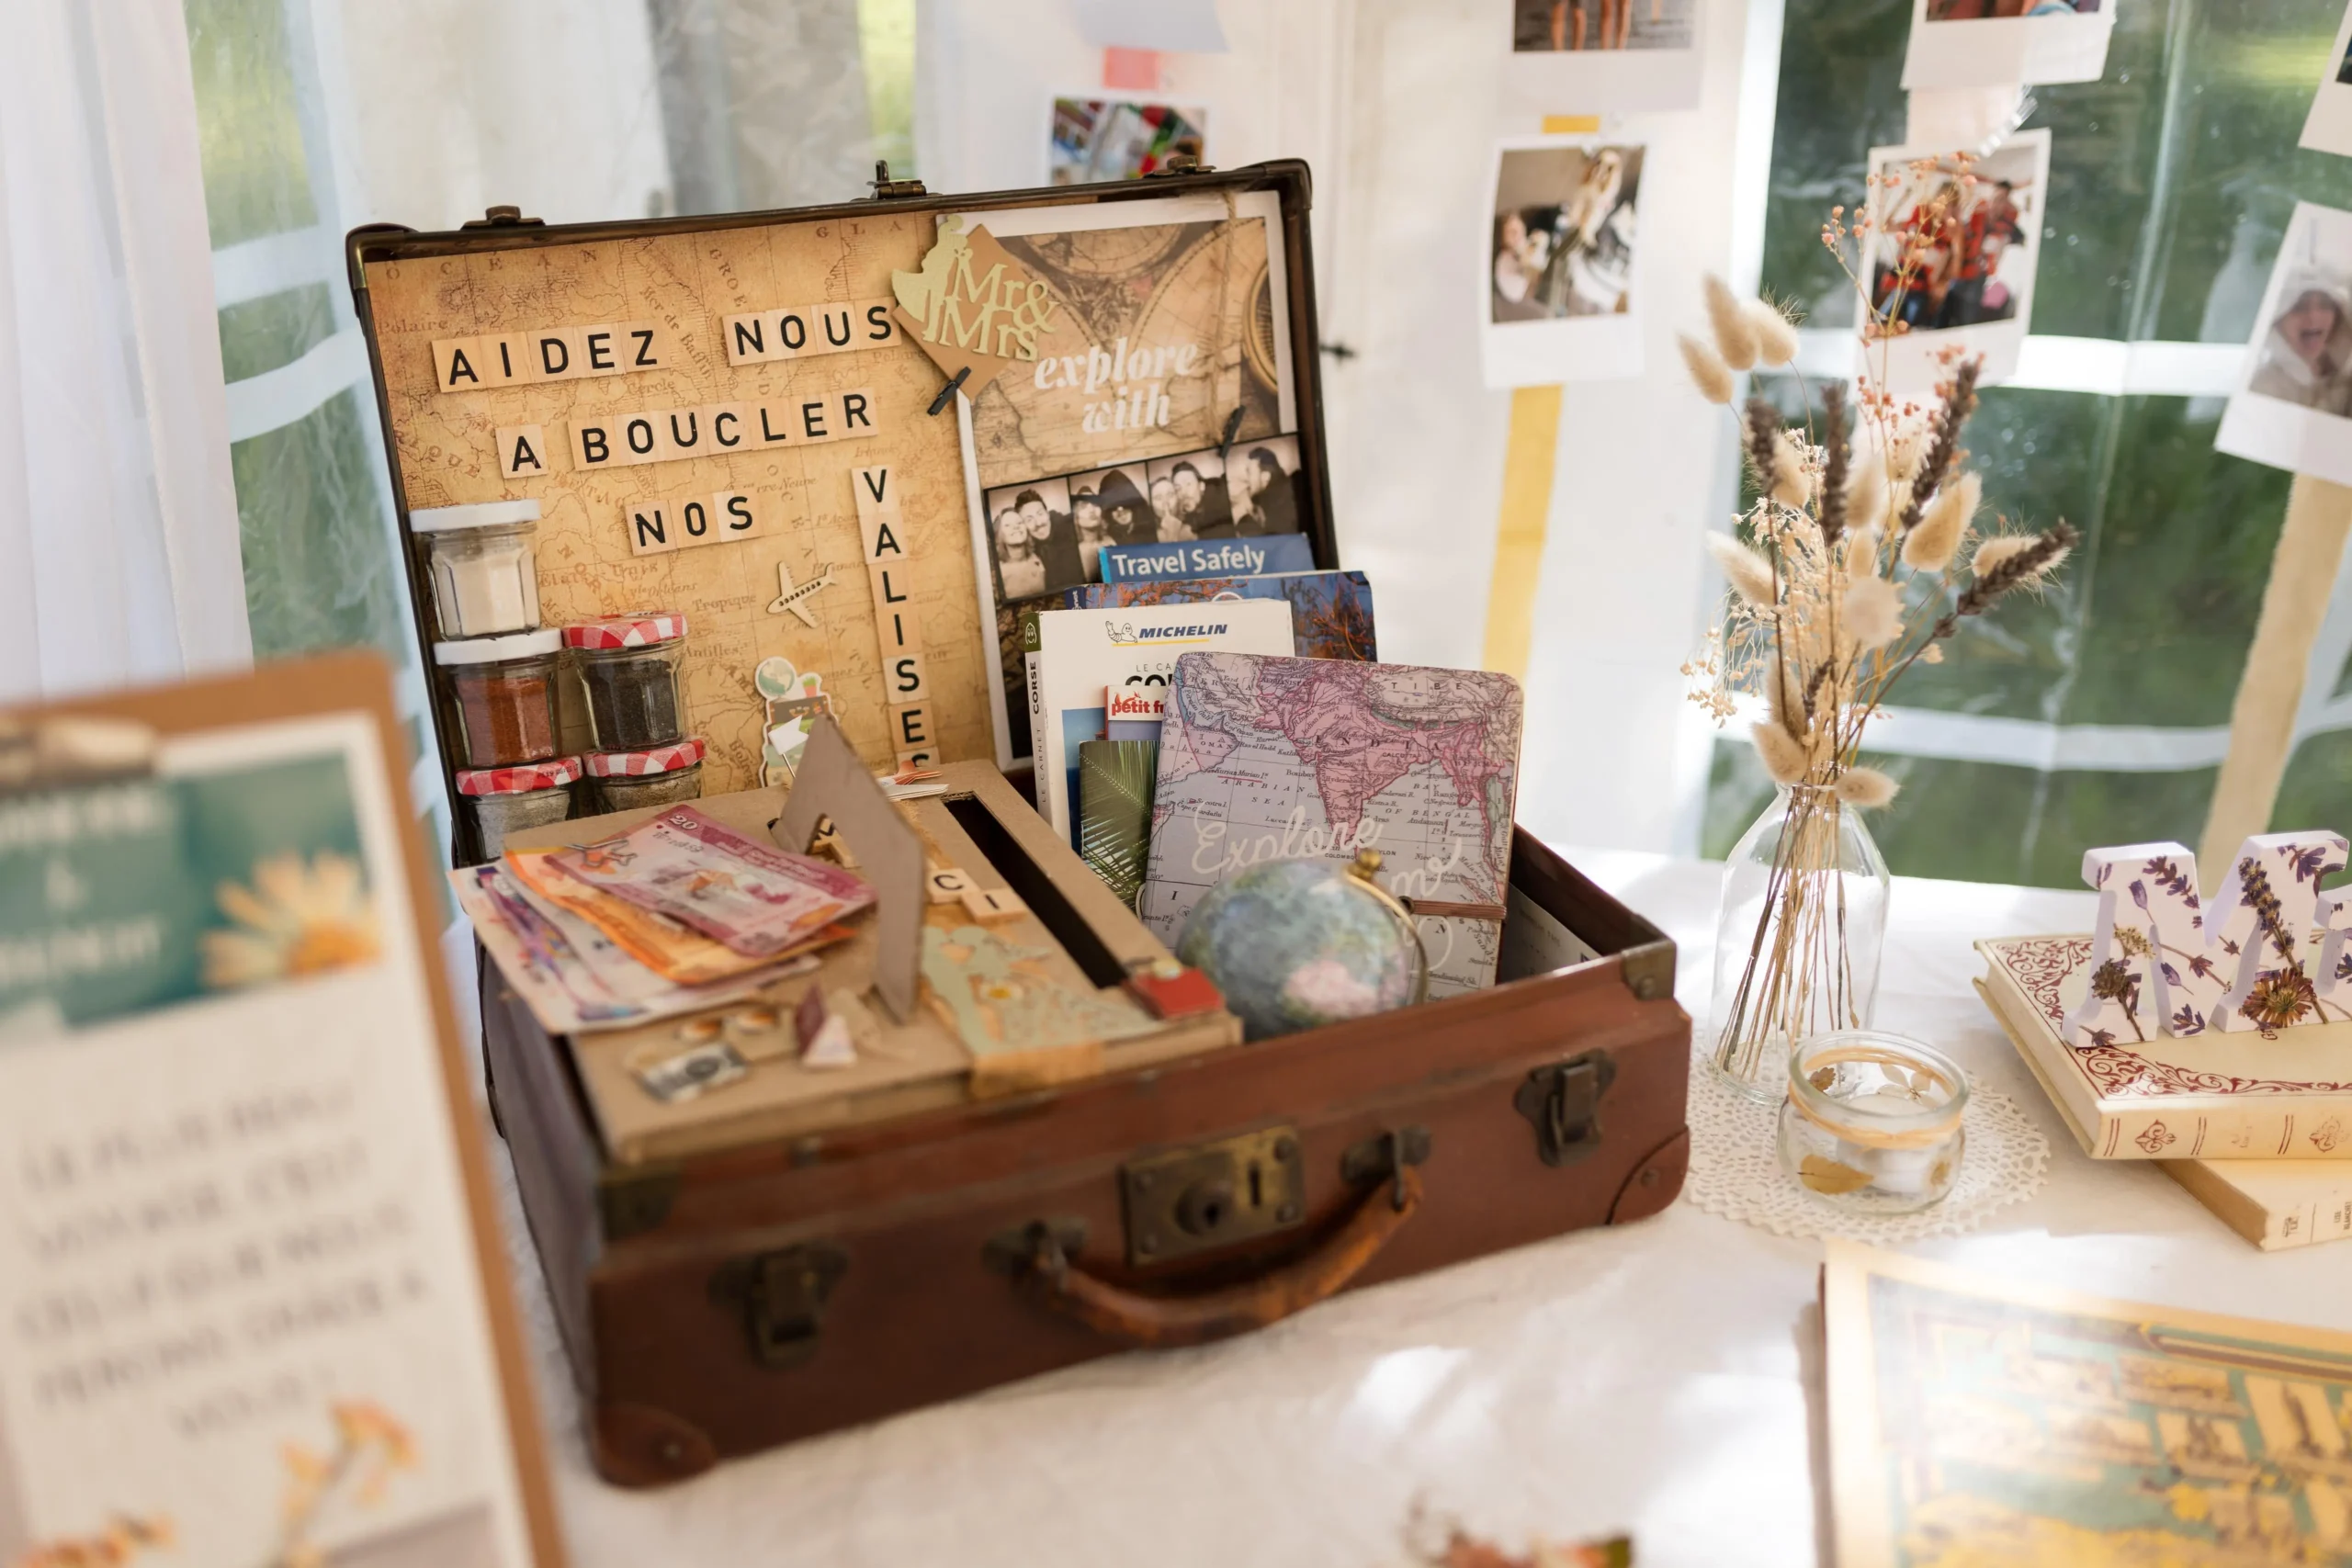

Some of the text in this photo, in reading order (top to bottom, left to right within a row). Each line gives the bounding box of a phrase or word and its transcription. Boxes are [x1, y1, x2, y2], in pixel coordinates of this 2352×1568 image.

[939, 294, 1039, 362] Mrs
[447, 305, 893, 386] AIDEZ NOUS
[1035, 336, 1198, 395] explore
[1081, 383, 1170, 434] with
[511, 393, 872, 472] A BOUCLER
[635, 495, 753, 548] NOS
[1112, 545, 1266, 577] Travel Safely
[1138, 624, 1228, 638] MICHELIN
[1136, 662, 1172, 672] LE CA
[1391, 681, 1484, 690] TIBET
[1111, 696, 1151, 716] petit
[1198, 710, 1214, 721] Gulf
[1334, 713, 1351, 721] Delhi
[1029, 660, 1046, 803] LE CARNET CORSE
[1200, 740, 1233, 750] OMAN
[1286, 769, 1316, 780] Bombay
[1221, 779, 1306, 793] ARABIAN
[1251, 796, 1286, 806] SEA
[669, 813, 698, 832] 20
[1411, 809, 1470, 818] BENGAL
[1192, 799, 1385, 875] Explore
